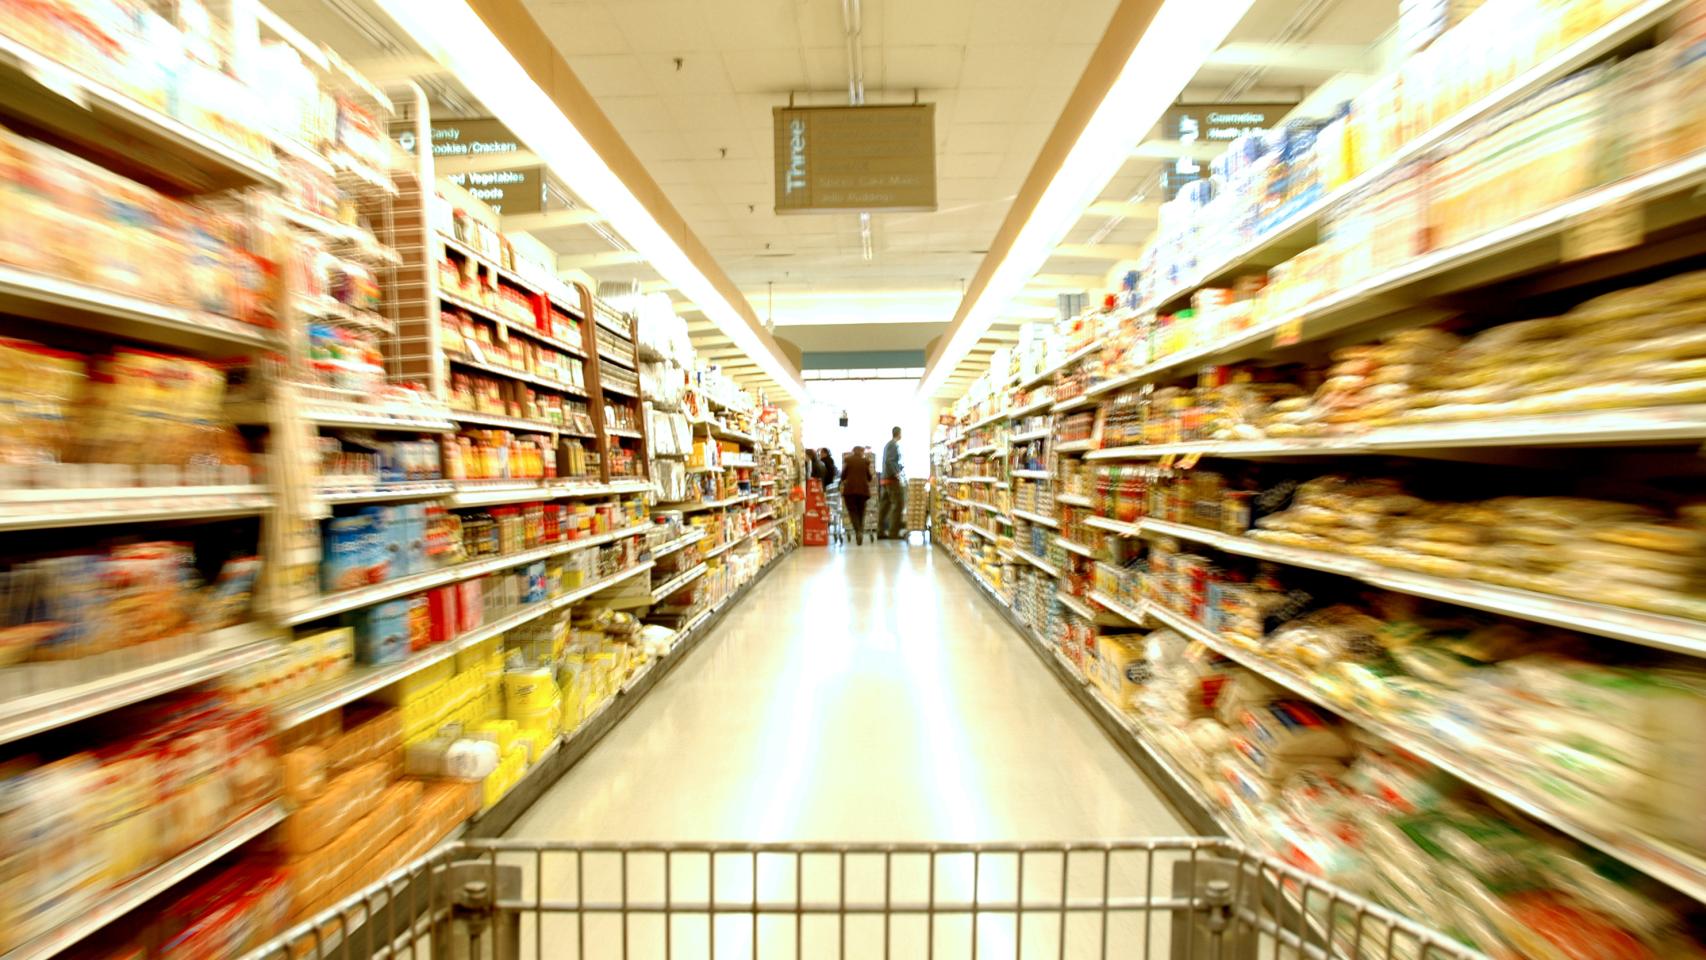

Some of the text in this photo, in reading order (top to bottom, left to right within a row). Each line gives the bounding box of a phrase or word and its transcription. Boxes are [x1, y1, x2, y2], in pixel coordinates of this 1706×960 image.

[430, 128, 460, 141] Candy
[786, 119, 807, 193] Three
[469, 171, 525, 185] Vegetables
[469, 187, 504, 200] Goods
